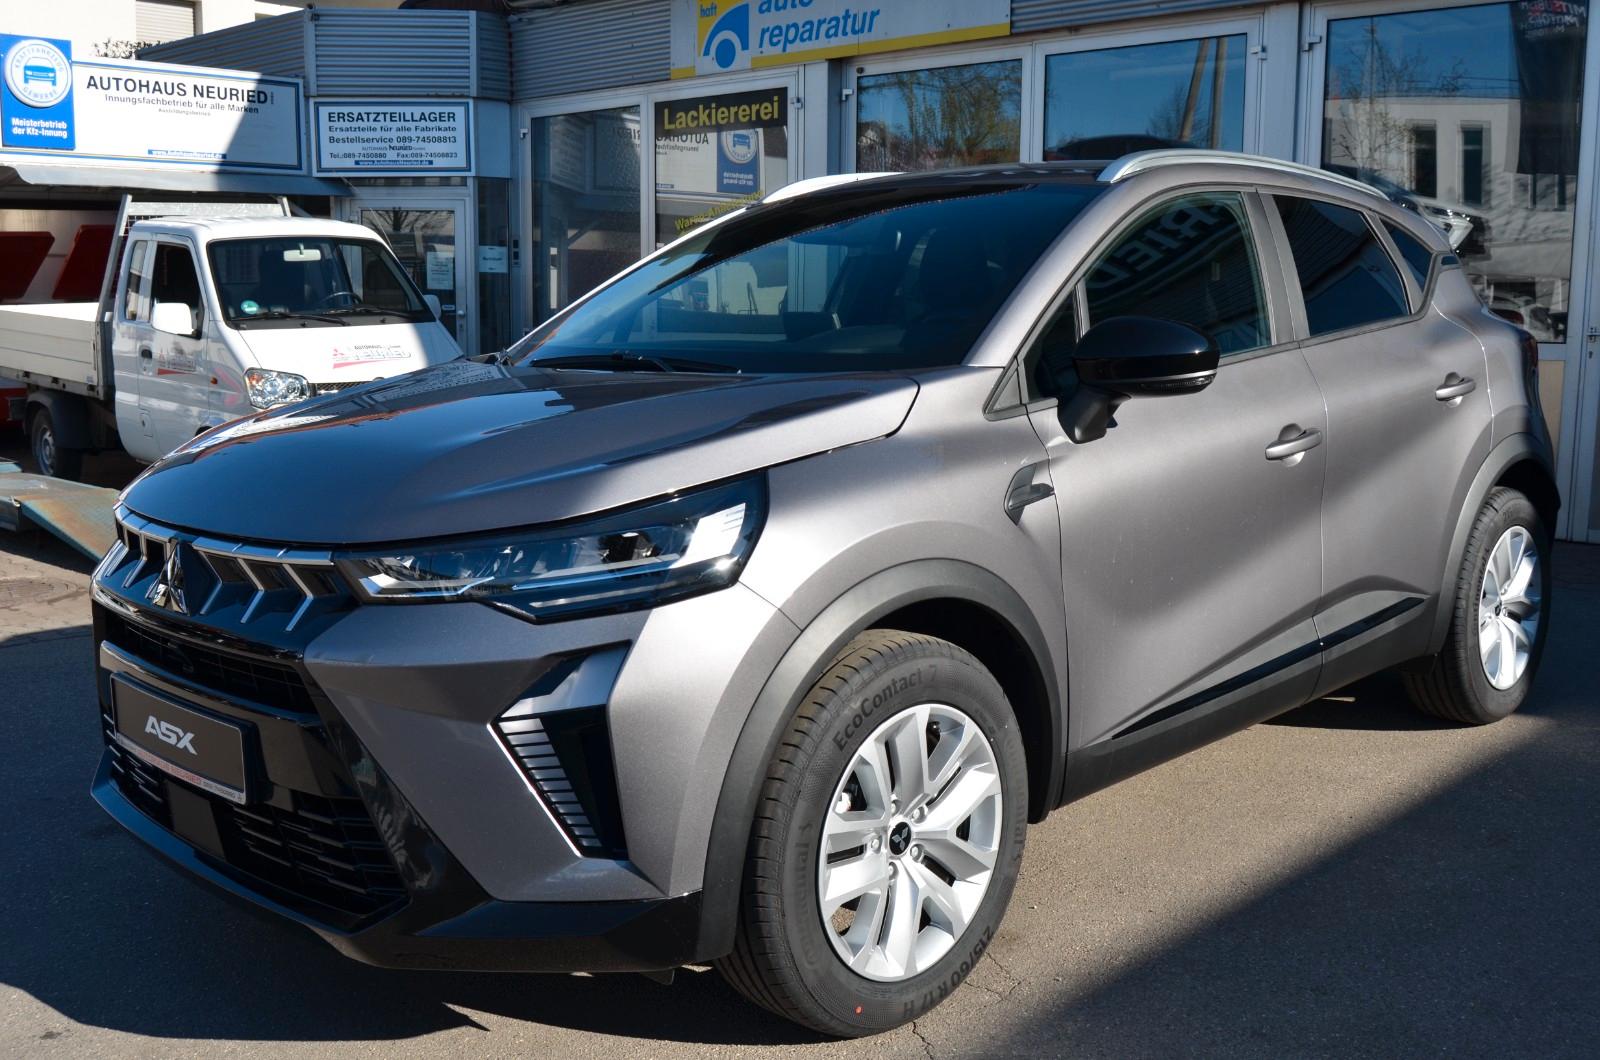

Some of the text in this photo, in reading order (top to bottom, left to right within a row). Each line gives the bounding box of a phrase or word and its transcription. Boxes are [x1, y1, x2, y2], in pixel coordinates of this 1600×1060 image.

[758, 8, 881, 52] reparatur
[86, 75, 188, 98] AUTOHAUS
[193, 84, 269, 104] NEURIED
[104, 94, 260, 114] Innungsfachbetrieb für alle Marken
[663, 95, 779, 130] Lackiererei
[11, 117, 67, 129] Meisterbetrieb
[328, 111, 456, 123] ERSATZTEILLAGER
[12, 126, 68, 139] der Kfz-Innung
[328, 125, 457, 133] Ersatzteile für alle Fabrikate
[328, 135, 457, 144] Bestellservice 089-74508813
[832, 667, 926, 753] EcoContact
[928, 664, 938, 682] 7
[144, 715, 198, 756] ASX
[950, 925, 994, 988] 215/60
[937, 980, 949, 998] R
